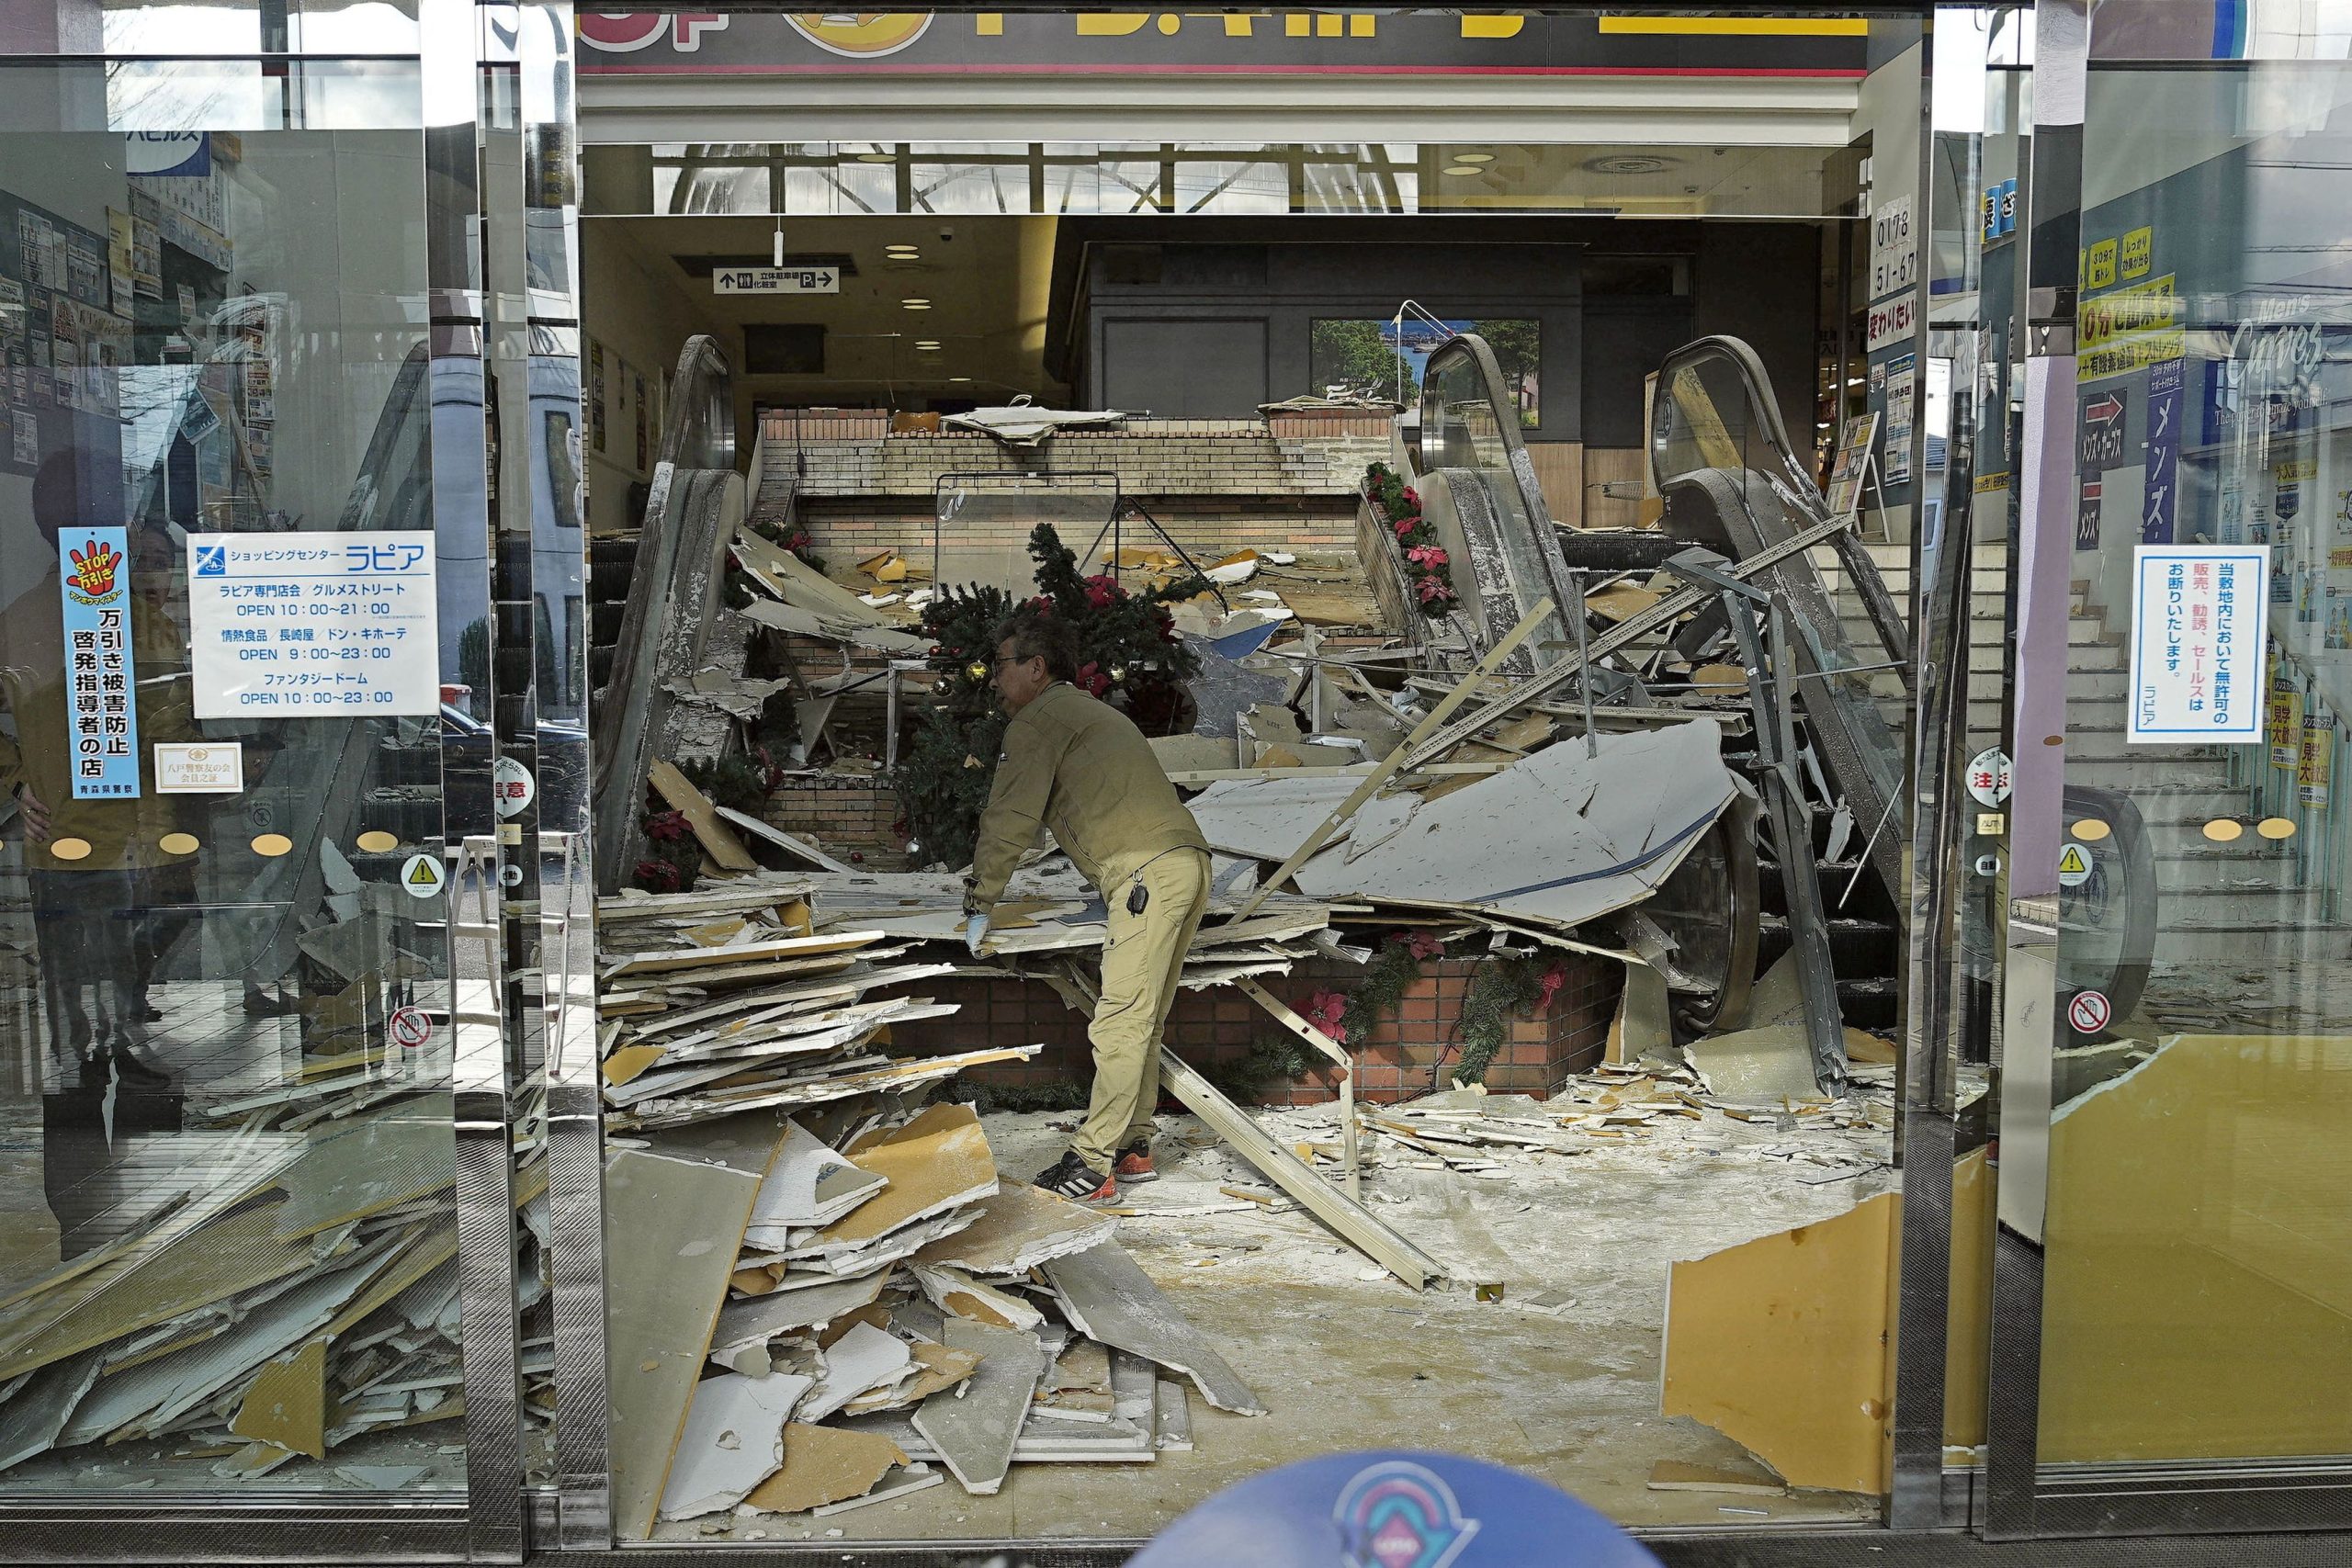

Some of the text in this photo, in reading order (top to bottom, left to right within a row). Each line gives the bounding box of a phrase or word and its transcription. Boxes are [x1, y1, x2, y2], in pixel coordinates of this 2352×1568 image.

[1877, 210, 1908, 247] 0178
[1876, 251, 1918, 291] 51-67
[1869, 298, 1917, 342] 変わりたい
[2078, 284, 2171, 342] 0分で出来る
[2258, 294, 2312, 323] Men's
[2227, 318, 2323, 384] Curves
[2215, 410, 2229, 425] The
[76, 553, 109, 575] STOP
[231, 544, 424, 571] ショッピングセンター ラピア
[77, 568, 115, 591] 万引き
[237, 604, 276, 616] OPEN
[2165, 563, 2184, 678] お断りいたします。
[2189, 563, 2210, 711] 販売、勧誘、セールスは
[2213, 563, 2235, 725] 当敷地内において無許可の
[239, 649, 277, 660] OPEN
[98, 608, 130, 757] 万引き被害防止
[264, 672, 368, 686] ファンタジードーム
[73, 630, 104, 778] 啓発指導者の店
[241, 693, 279, 705] OPEN
[2143, 686, 2156, 726] ラピア
[80, 784, 133, 795] 青森県警察
[506, 782, 526, 798] 意
[1973, 773, 1993, 788] 注
